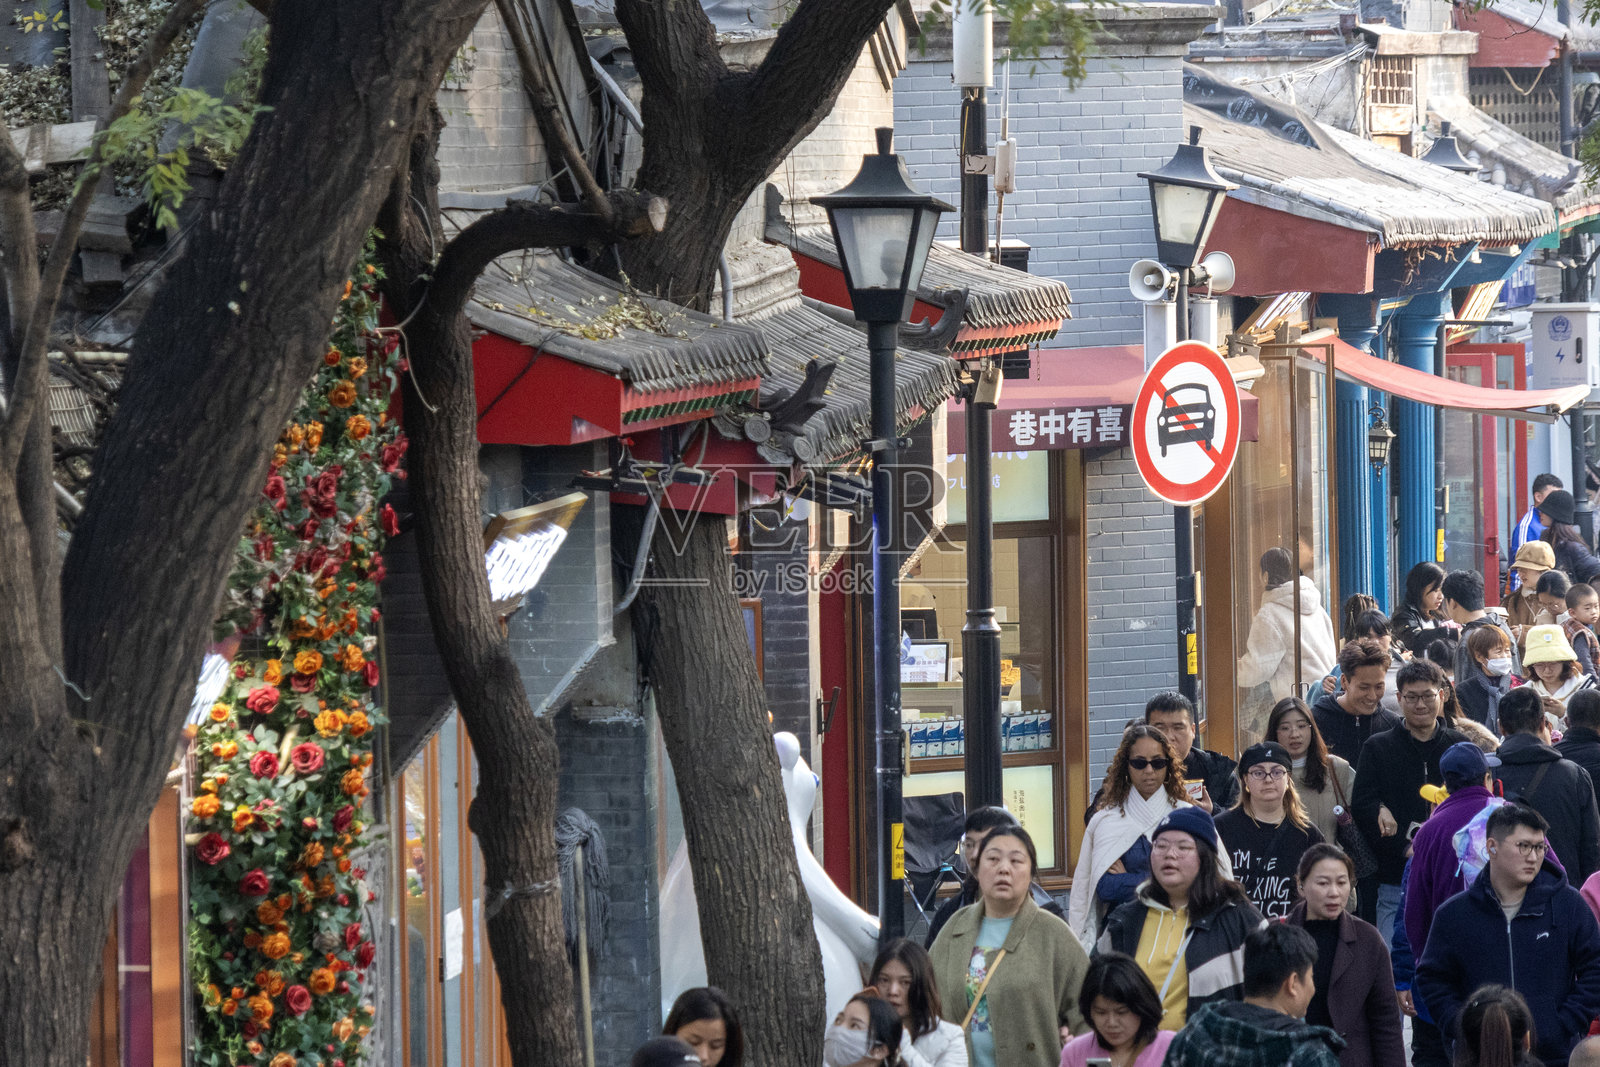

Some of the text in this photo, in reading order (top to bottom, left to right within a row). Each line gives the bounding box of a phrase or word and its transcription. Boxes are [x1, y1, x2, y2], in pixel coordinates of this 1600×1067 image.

[1009, 407, 1124, 446] 巷中有喜
[1233, 849, 1250, 869] I'M
